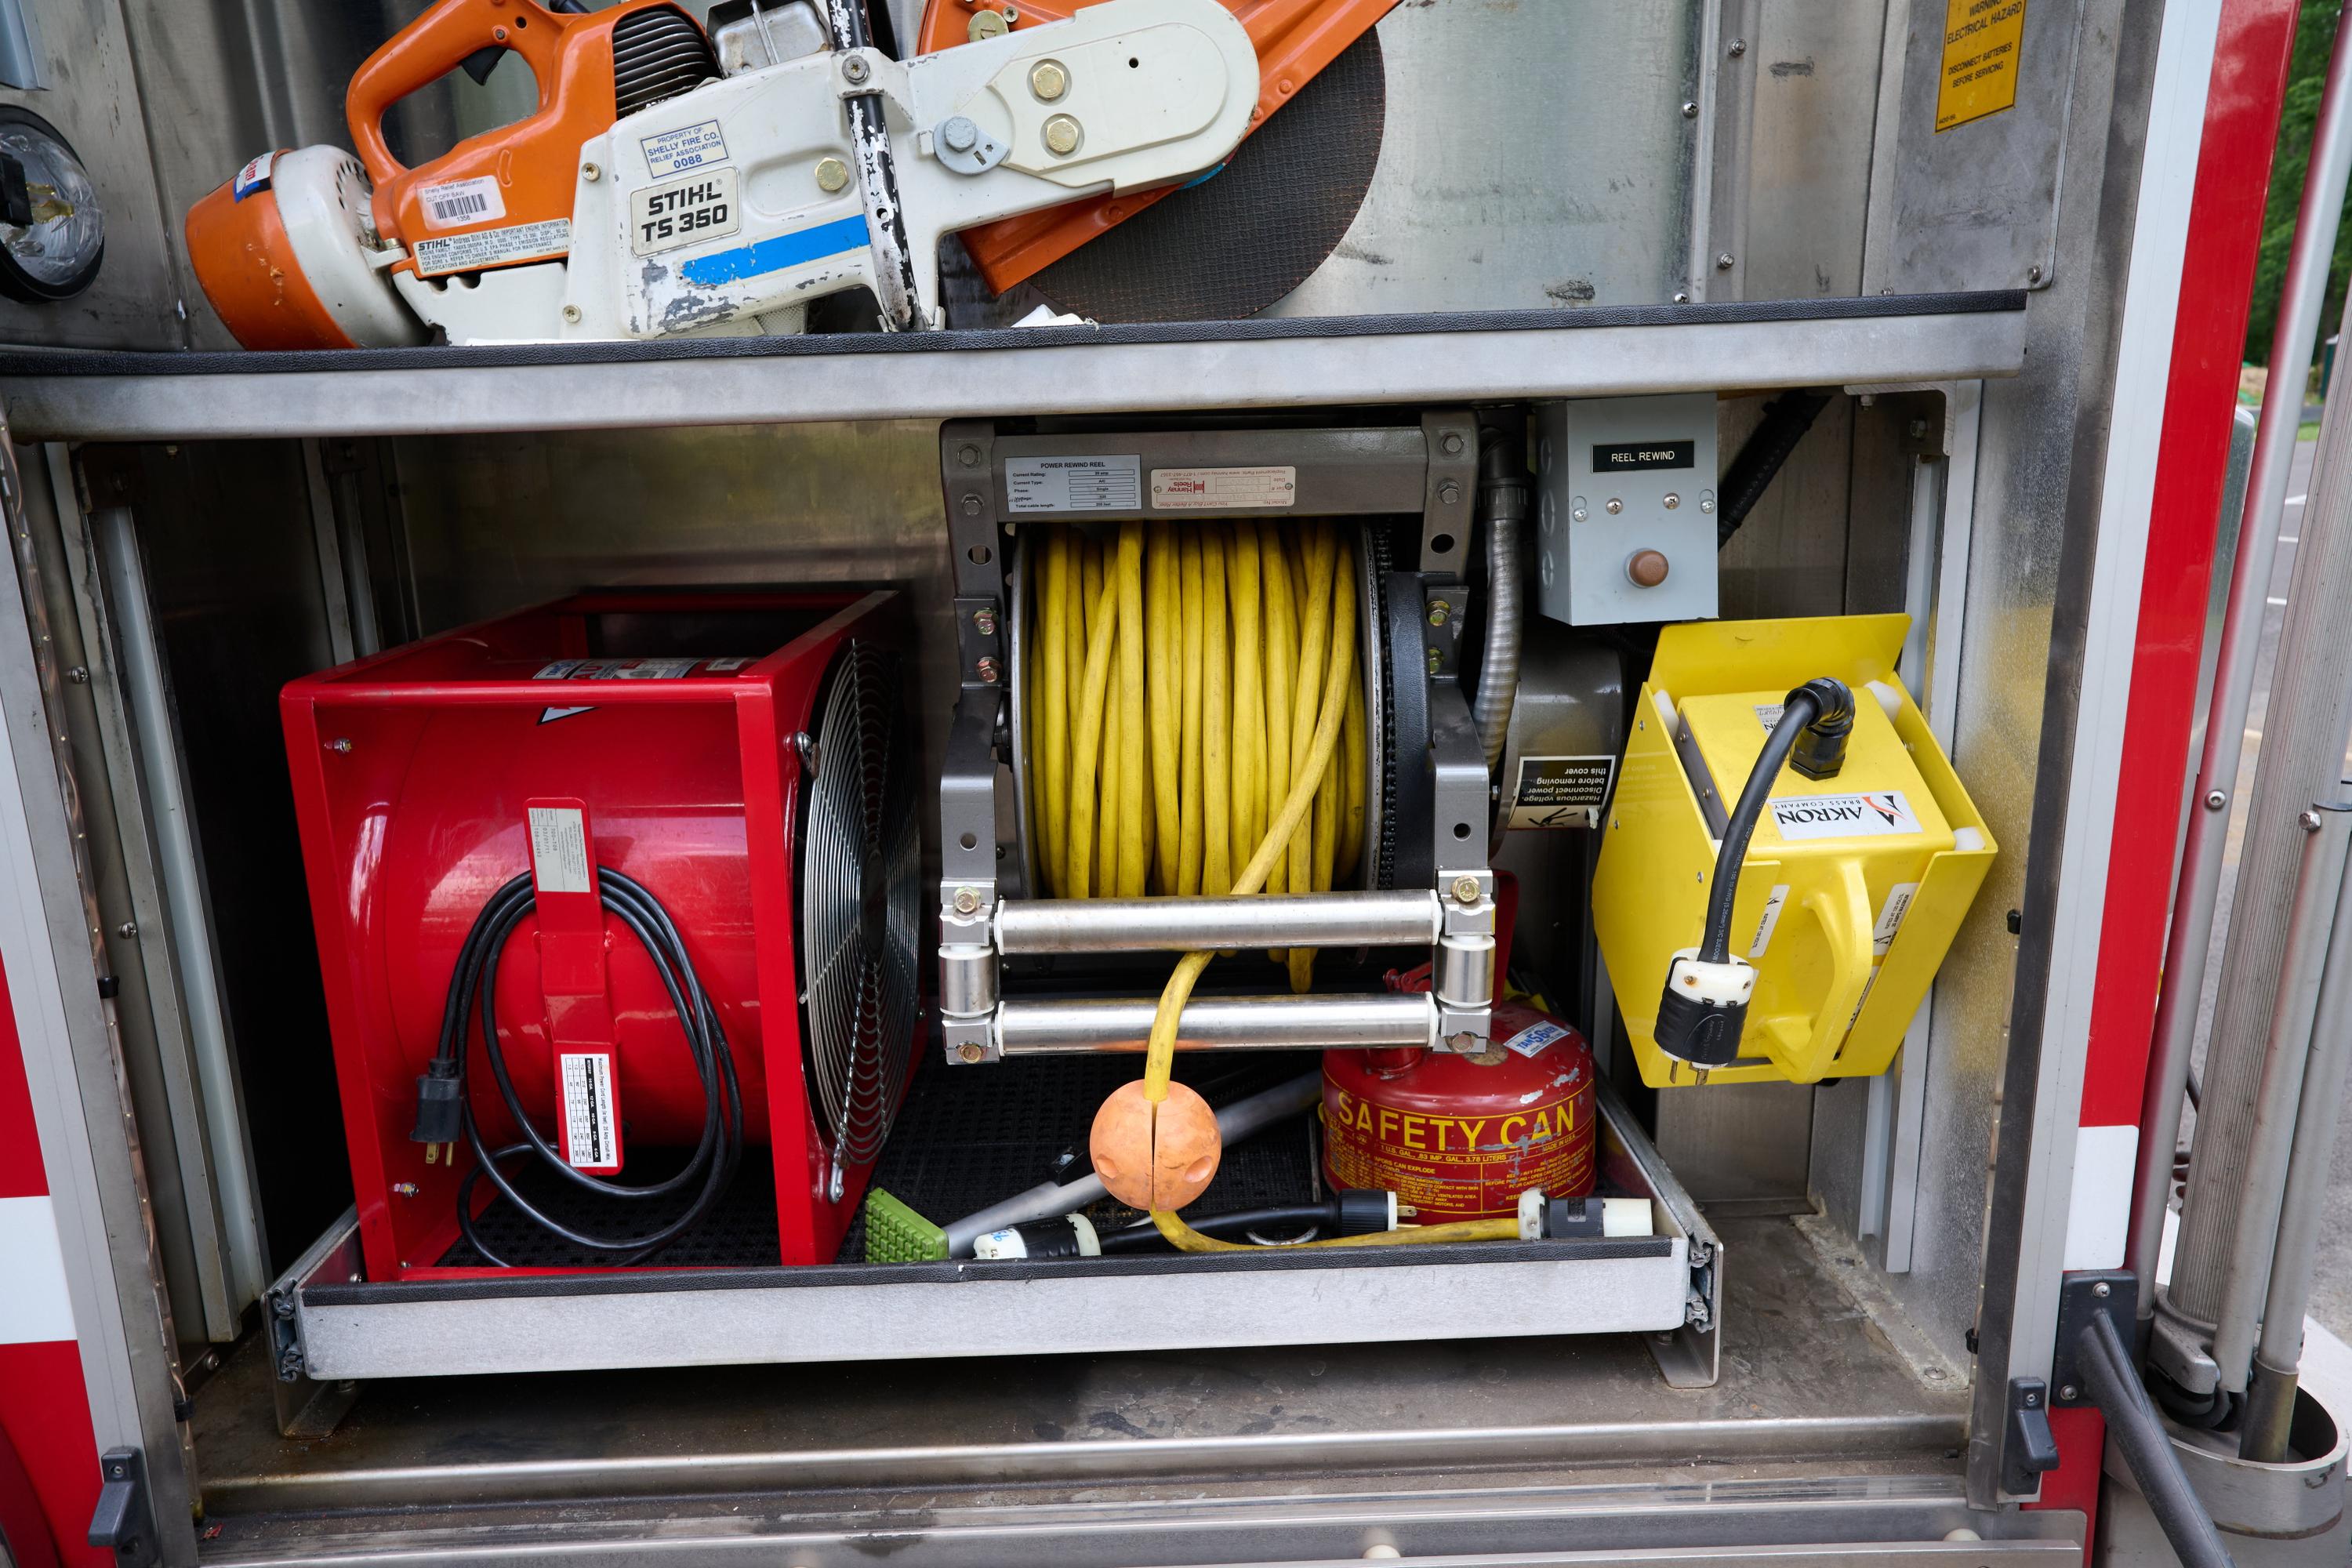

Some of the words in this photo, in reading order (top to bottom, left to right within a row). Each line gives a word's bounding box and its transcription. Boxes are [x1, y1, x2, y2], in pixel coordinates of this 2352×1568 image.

[1947, 17, 1987, 44] ELECTRICAL
[1991, 2, 2022, 25] HAZARD
[1948, 55, 1981, 75] DISCONNECT
[1983, 42, 2013, 62] BATTERIES
[1952, 73, 1973, 88] BEFORE
[1975, 60, 2004, 79] SERVICING
[648, 142, 679, 157] SHELLY
[682, 136, 701, 147] FIRE
[703, 132, 719, 141] CO.
[657, 130, 691, 144] PROPERTY
[650, 153, 673, 164] RELIEF
[676, 140, 721, 158] ASSOCIATION
[673, 154, 702, 169] 0088
[456, 179, 485, 188] Association
[648, 182, 722, 216] STIHL
[641, 217, 673, 242] TS
[678, 204, 728, 232] 350
[418, 238, 450, 251] STIHL
[1611, 452, 1635, 463] REEL
[1639, 450, 1675, 461] REWIND
[1537, 777, 1576, 786] removing
[1777, 807, 1862, 825] AKRON
[1338, 1091, 1486, 1152] SAFETY
[1501, 1100, 1573, 1149] CAN
[1385, 1145, 1397, 1154] U.S.
[1543, 1141, 1558, 1152] MADE
[1407, 1164, 1436, 1174] EXPLODE
